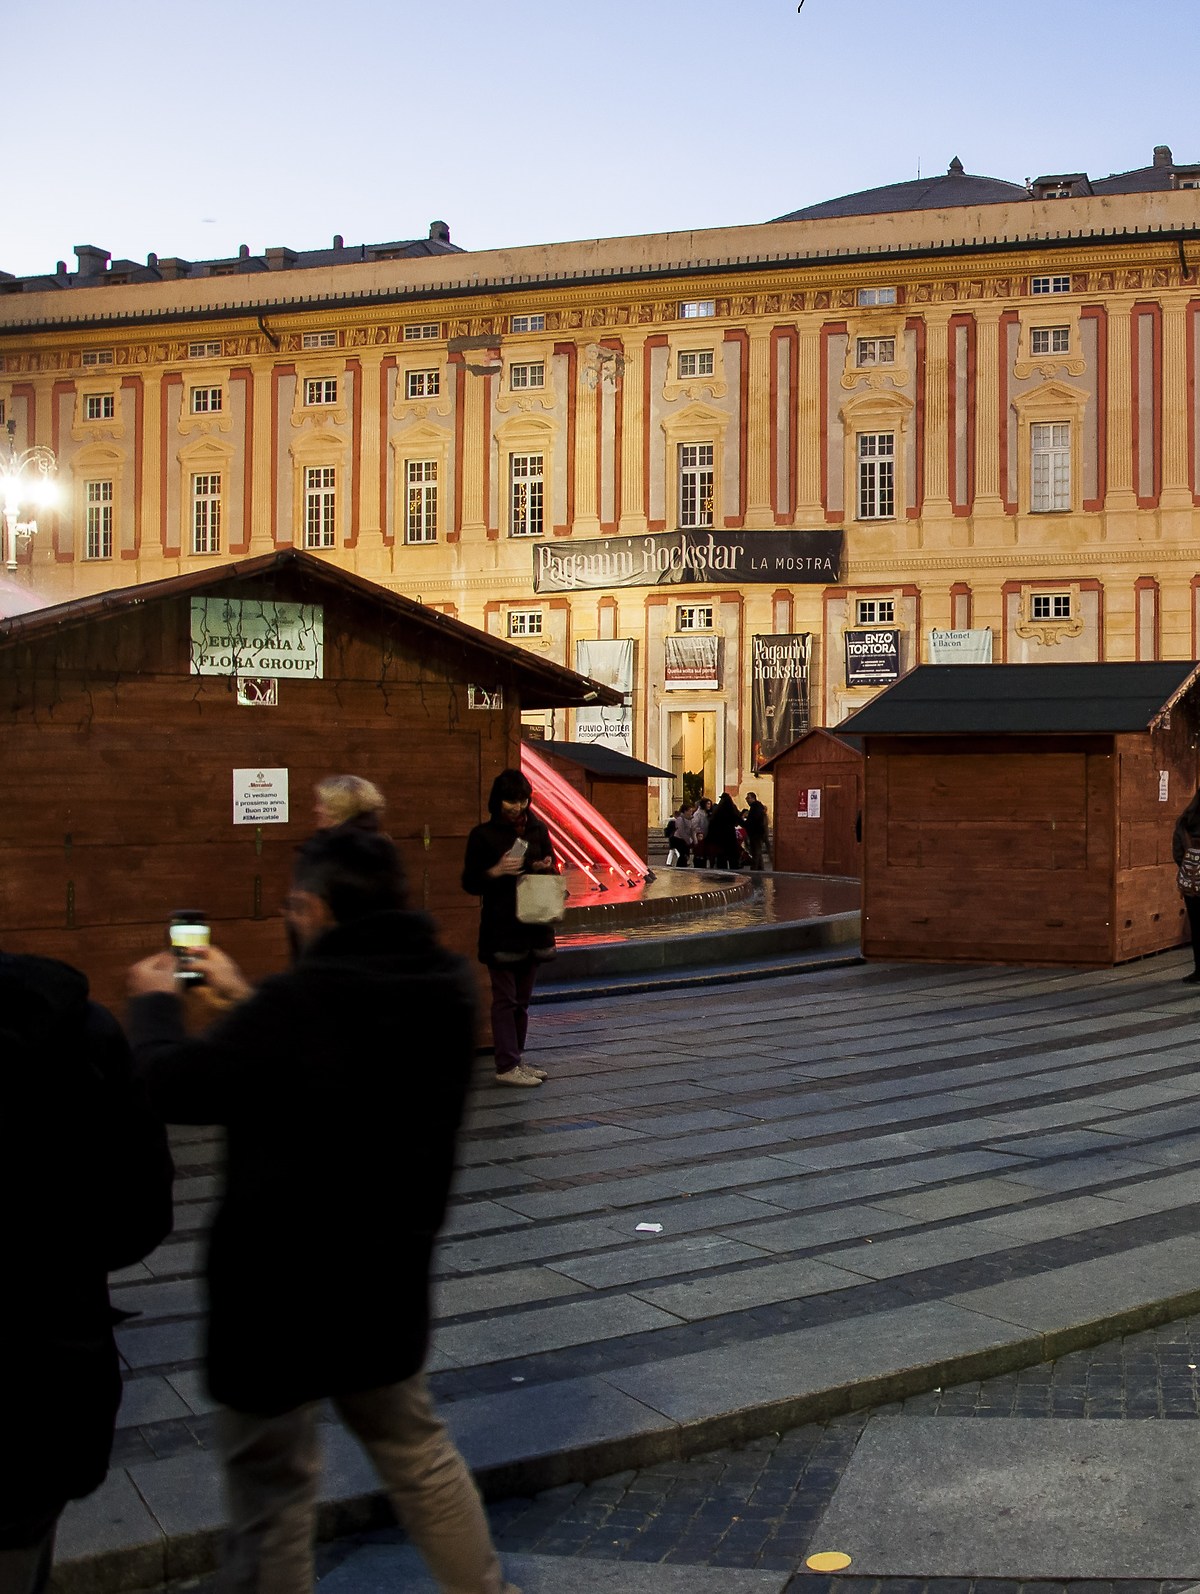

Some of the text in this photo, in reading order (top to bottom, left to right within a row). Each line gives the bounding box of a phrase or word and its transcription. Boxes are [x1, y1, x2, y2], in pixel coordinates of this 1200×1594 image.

[537, 533, 832, 589] Paganini Rockstar LA MOSTRA
[865, 633, 893, 644] ENZO
[932, 632, 970, 640] Da Monet
[208, 635, 293, 651] EUFLORIA
[848, 643, 897, 654] TORTORA
[199, 655, 316, 671] FLORA GROUP
[754, 659, 808, 679] Rockstar
[578, 724, 630, 733] FULVIO ROITER
